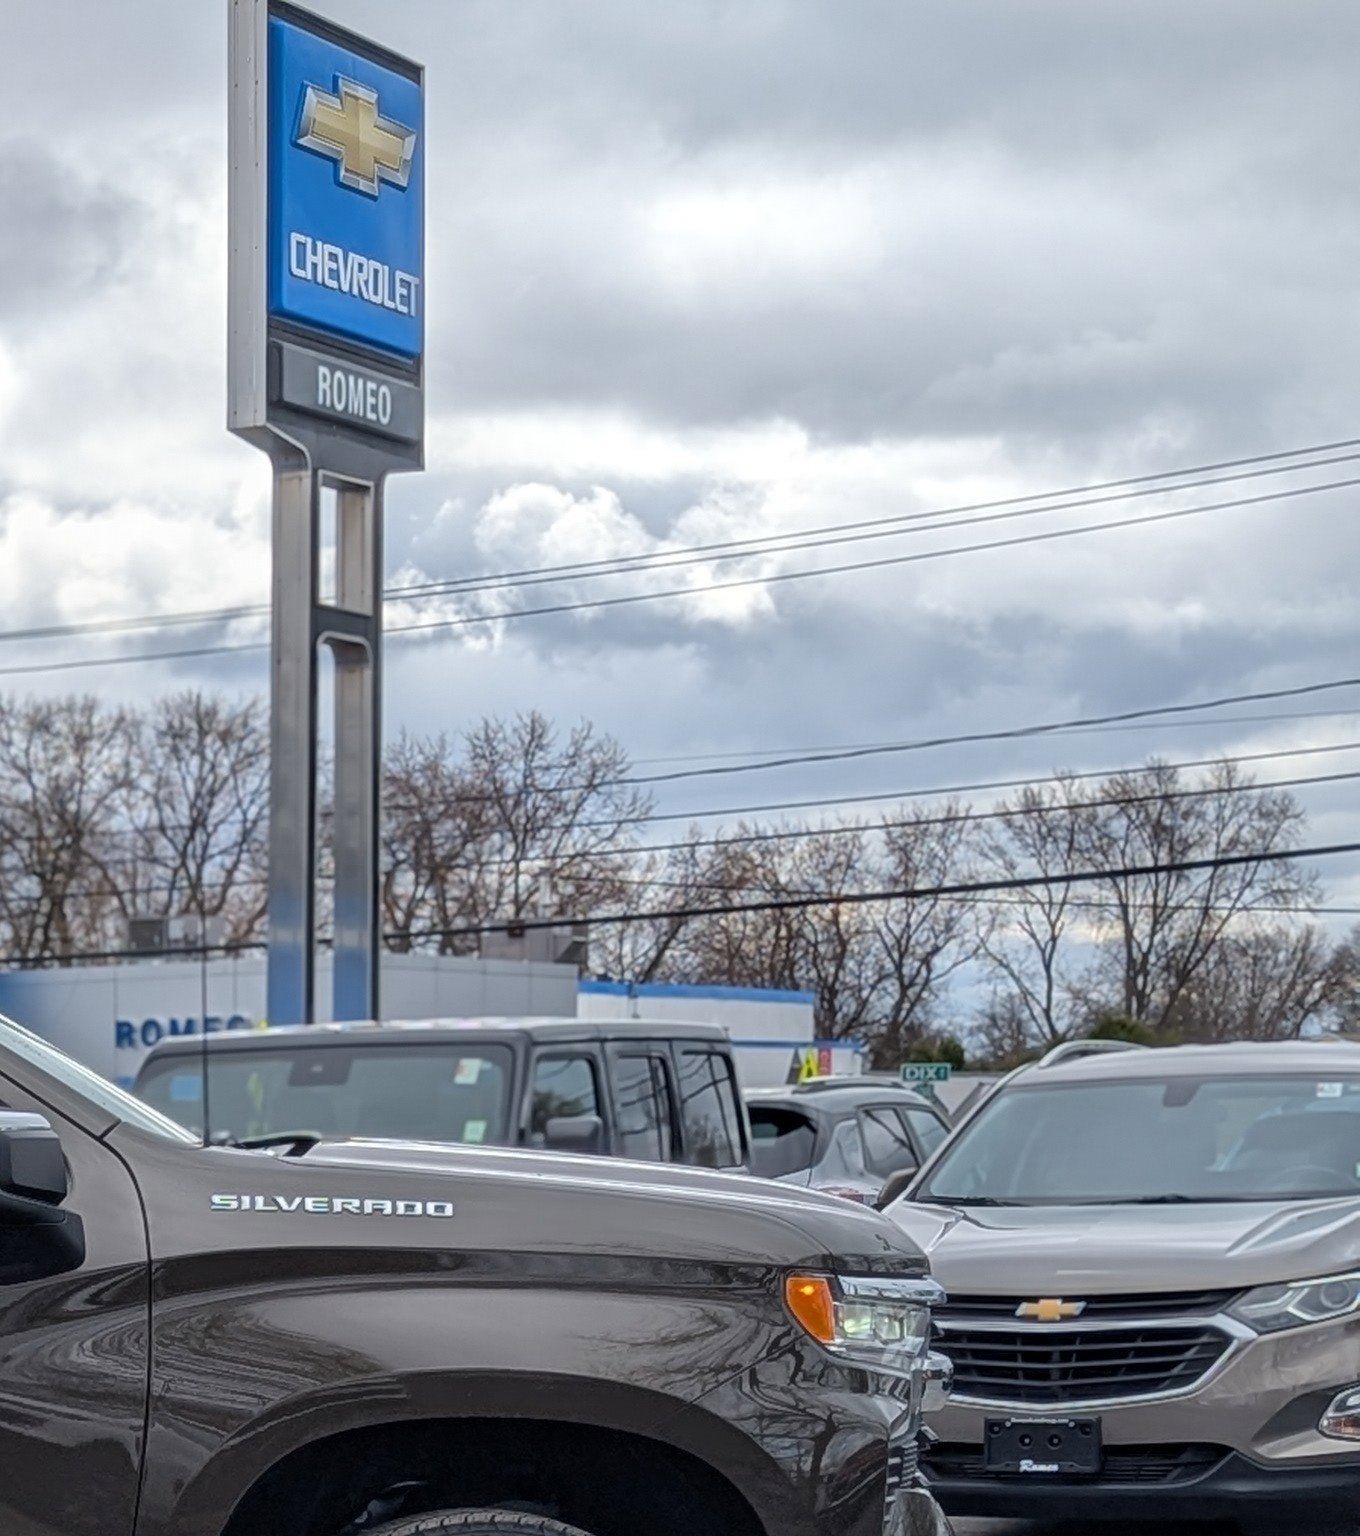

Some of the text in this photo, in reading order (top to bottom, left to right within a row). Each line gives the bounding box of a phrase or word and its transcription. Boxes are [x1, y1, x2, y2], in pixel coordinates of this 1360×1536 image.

[290, 231, 419, 317] CHEVROLET
[318, 366, 392, 425] ROMEO
[210, 1194, 454, 1217] SILVERADO
